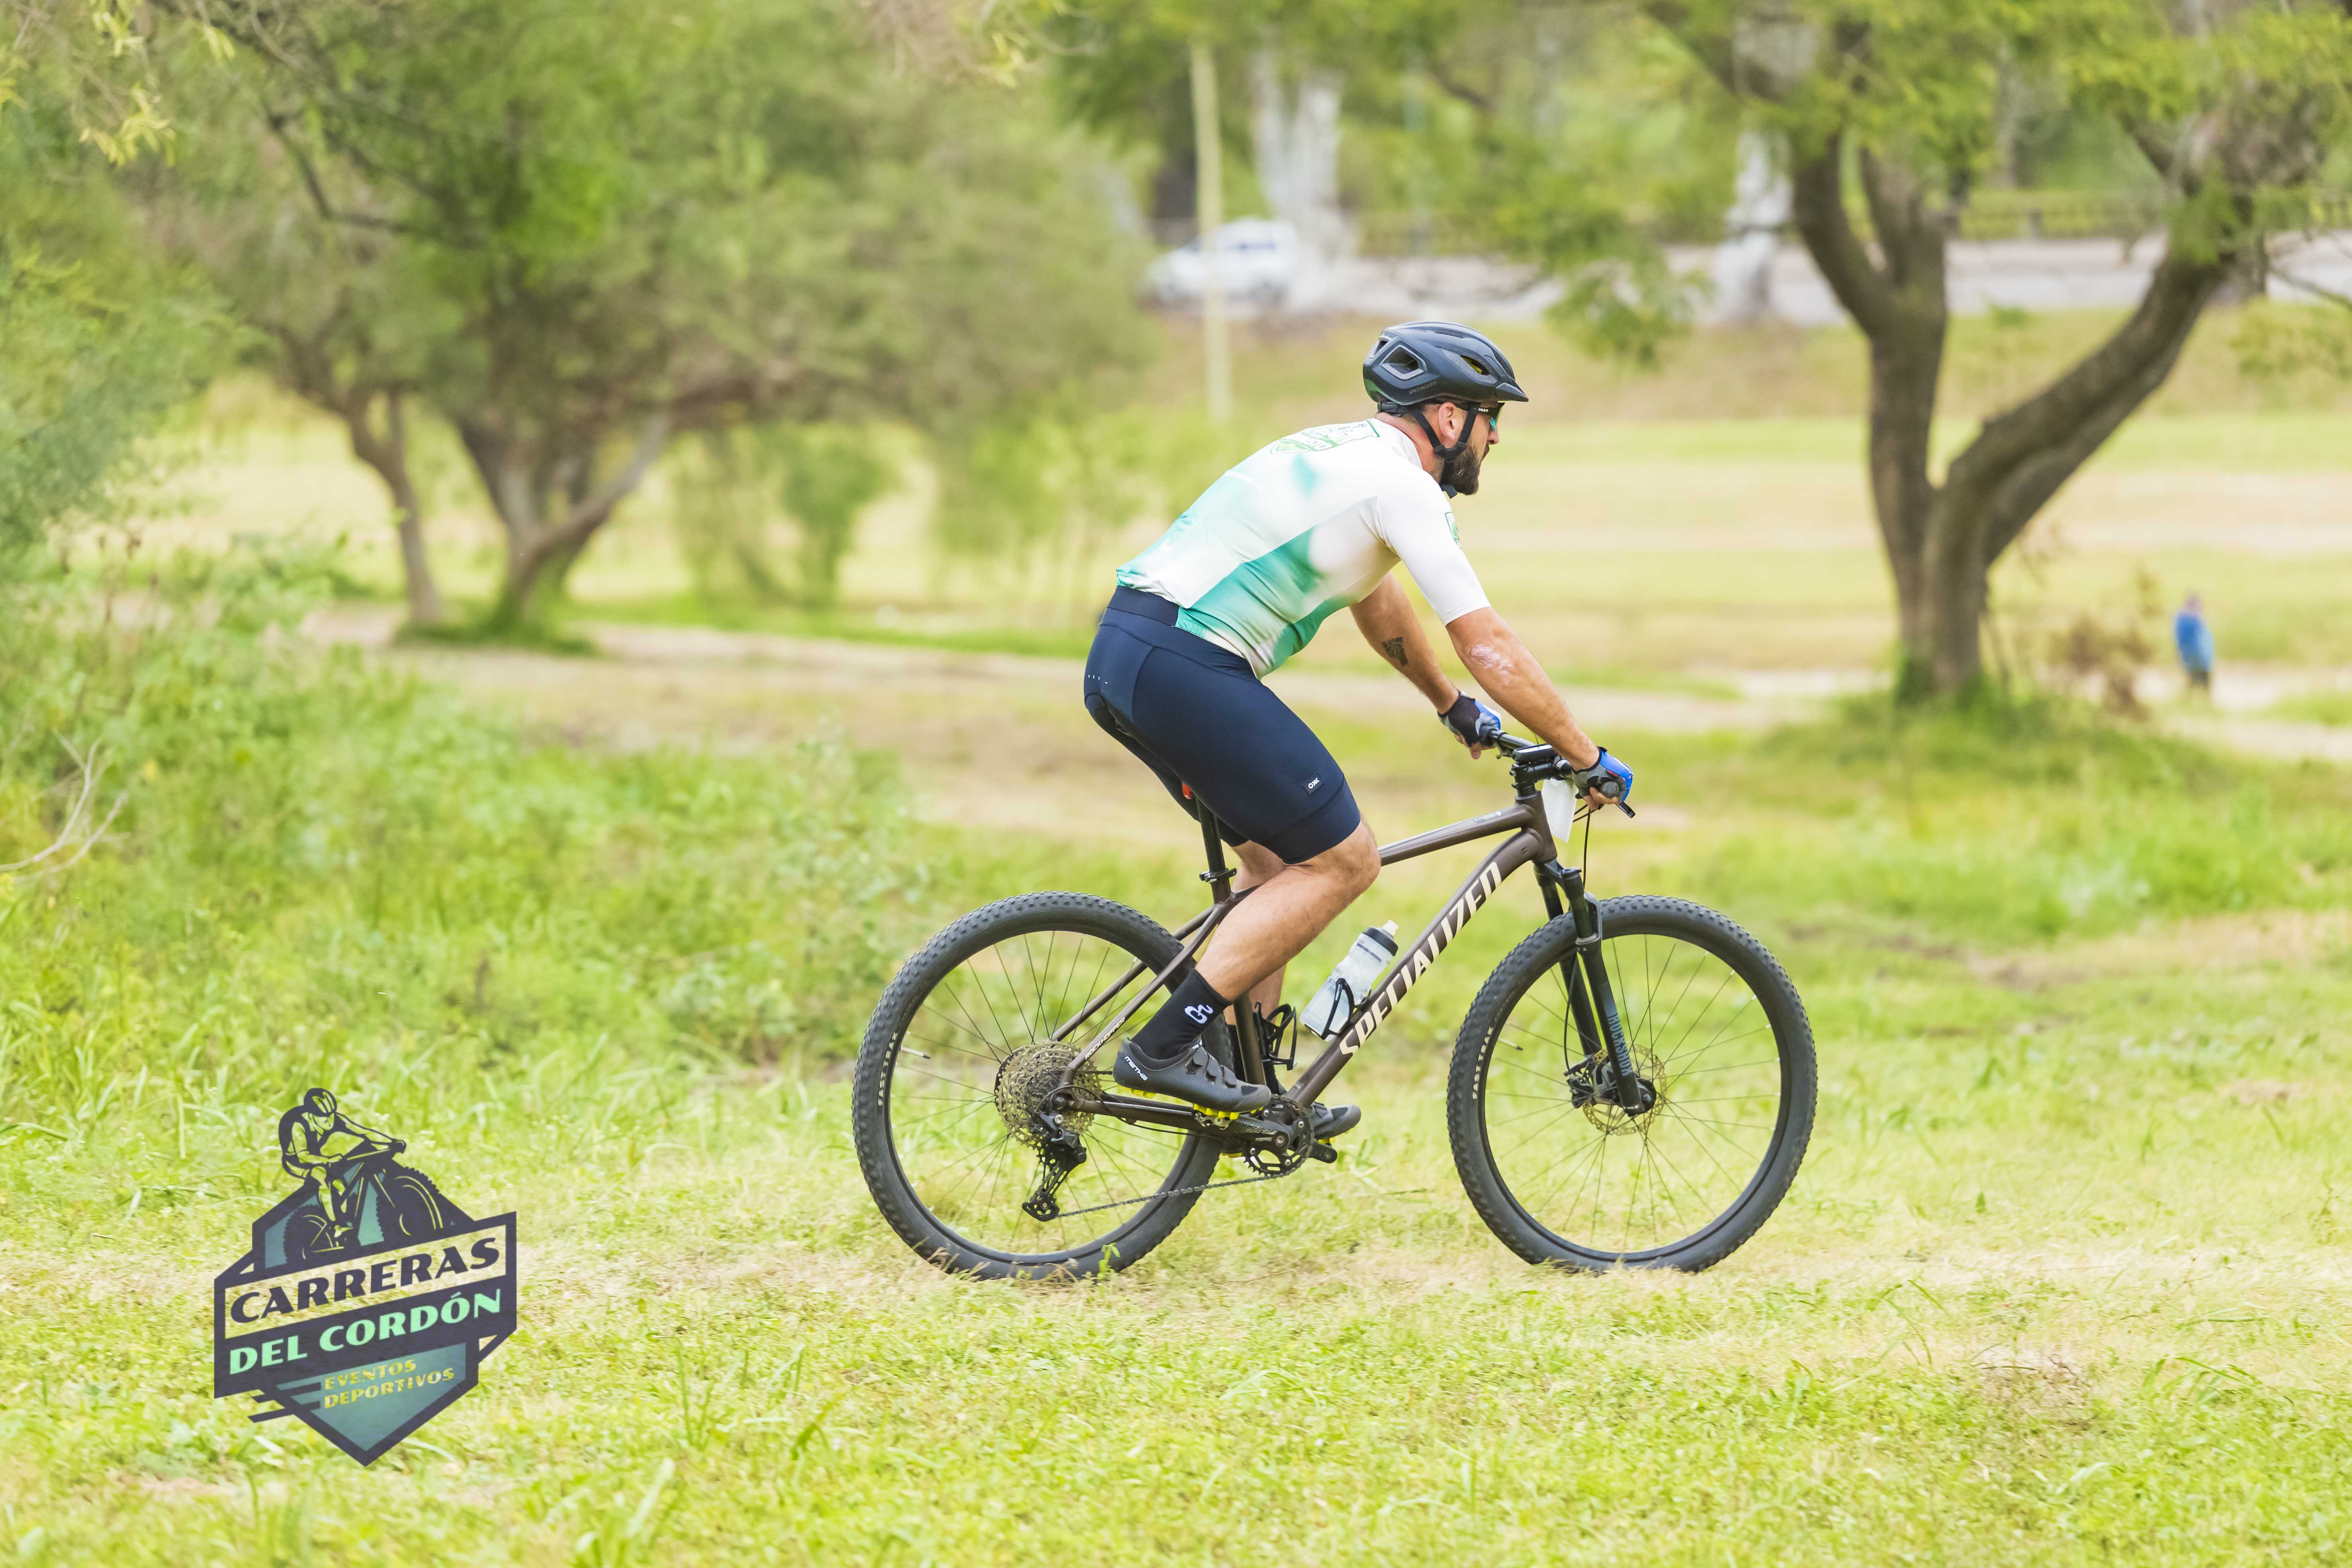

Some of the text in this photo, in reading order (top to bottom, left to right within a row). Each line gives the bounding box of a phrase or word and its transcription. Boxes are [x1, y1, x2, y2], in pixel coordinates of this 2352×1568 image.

[1339, 861, 1502, 1056] SPECIALIZED
[1084, 1017, 1125, 1060] ROCKHOPPER
[878, 1070, 886, 1106] FAST
[1472, 1064, 1481, 1100] FAST
